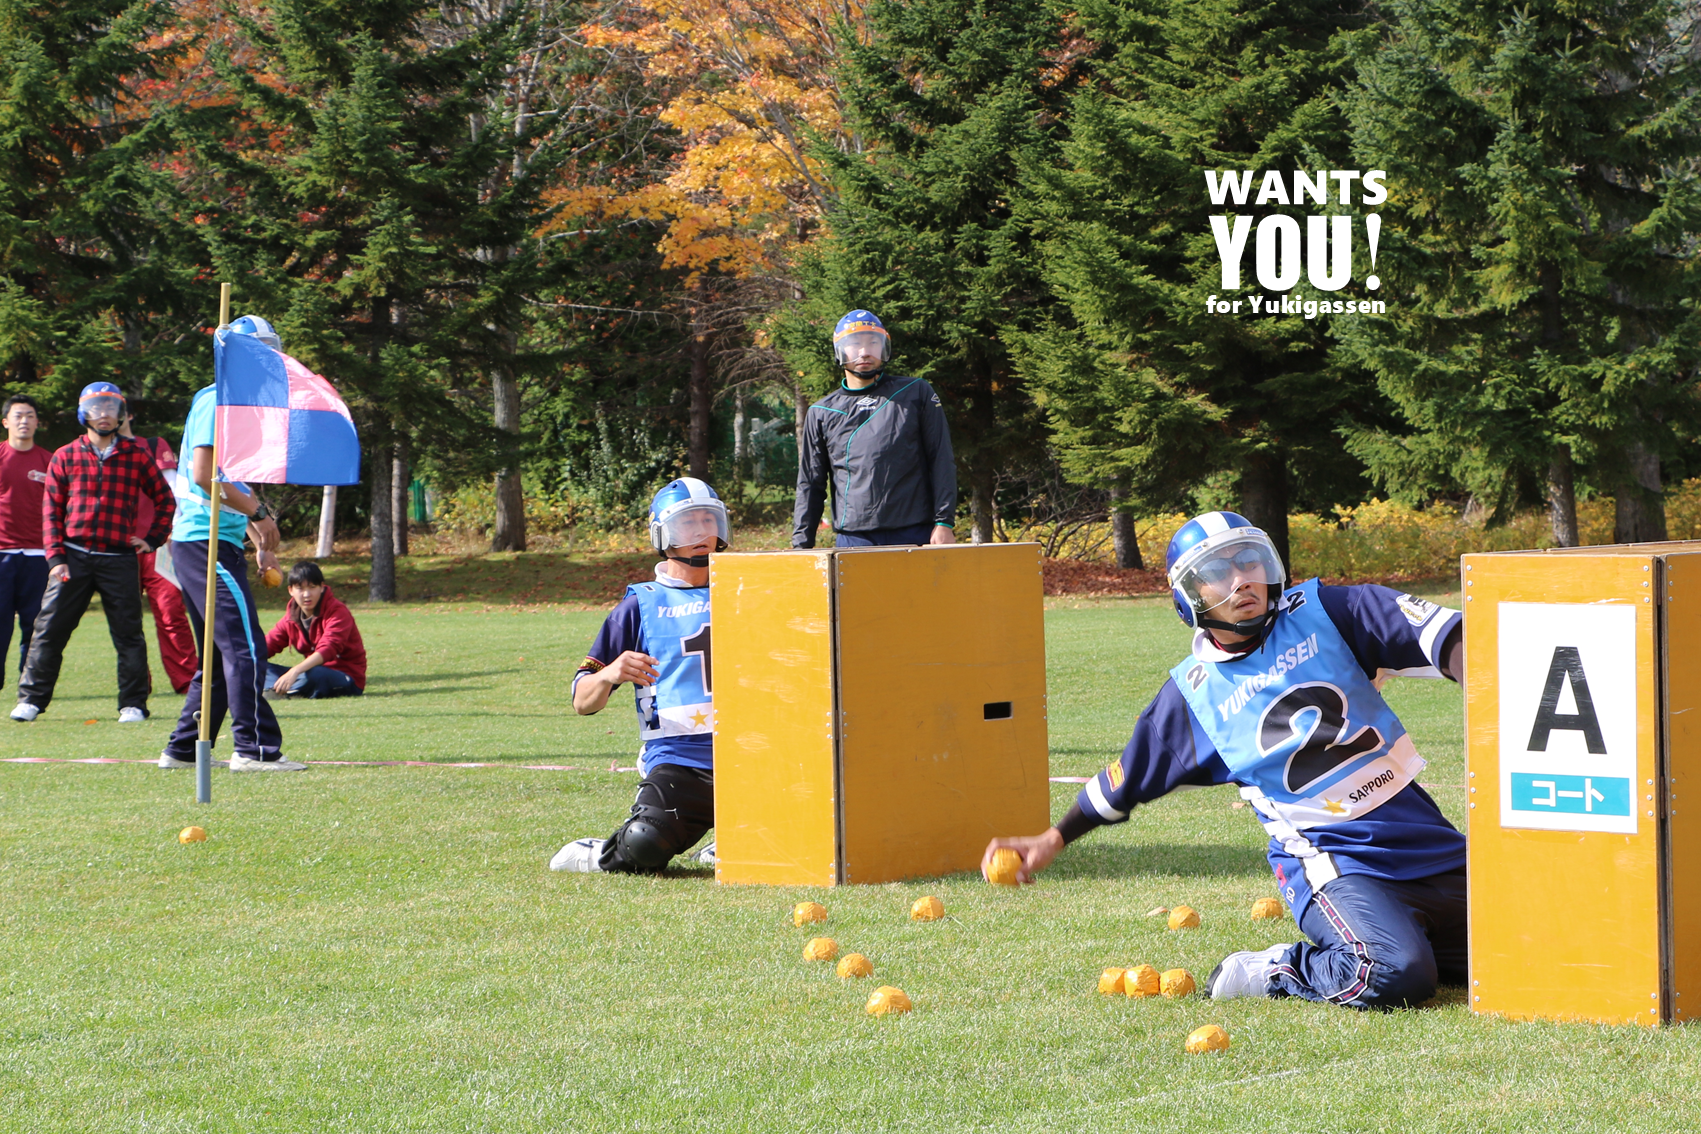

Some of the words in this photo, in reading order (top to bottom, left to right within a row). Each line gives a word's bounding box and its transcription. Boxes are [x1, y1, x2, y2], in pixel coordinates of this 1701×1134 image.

[1286, 590, 1307, 615] 2
[1186, 662, 1210, 693] 2
[1217, 632, 1320, 722] YUKIGASSEN
[1526, 646, 1607, 754] A
[1256, 681, 1386, 795] 2
[1348, 769, 1395, 804] SAPPORO
[1531, 777, 1605, 812] コート
